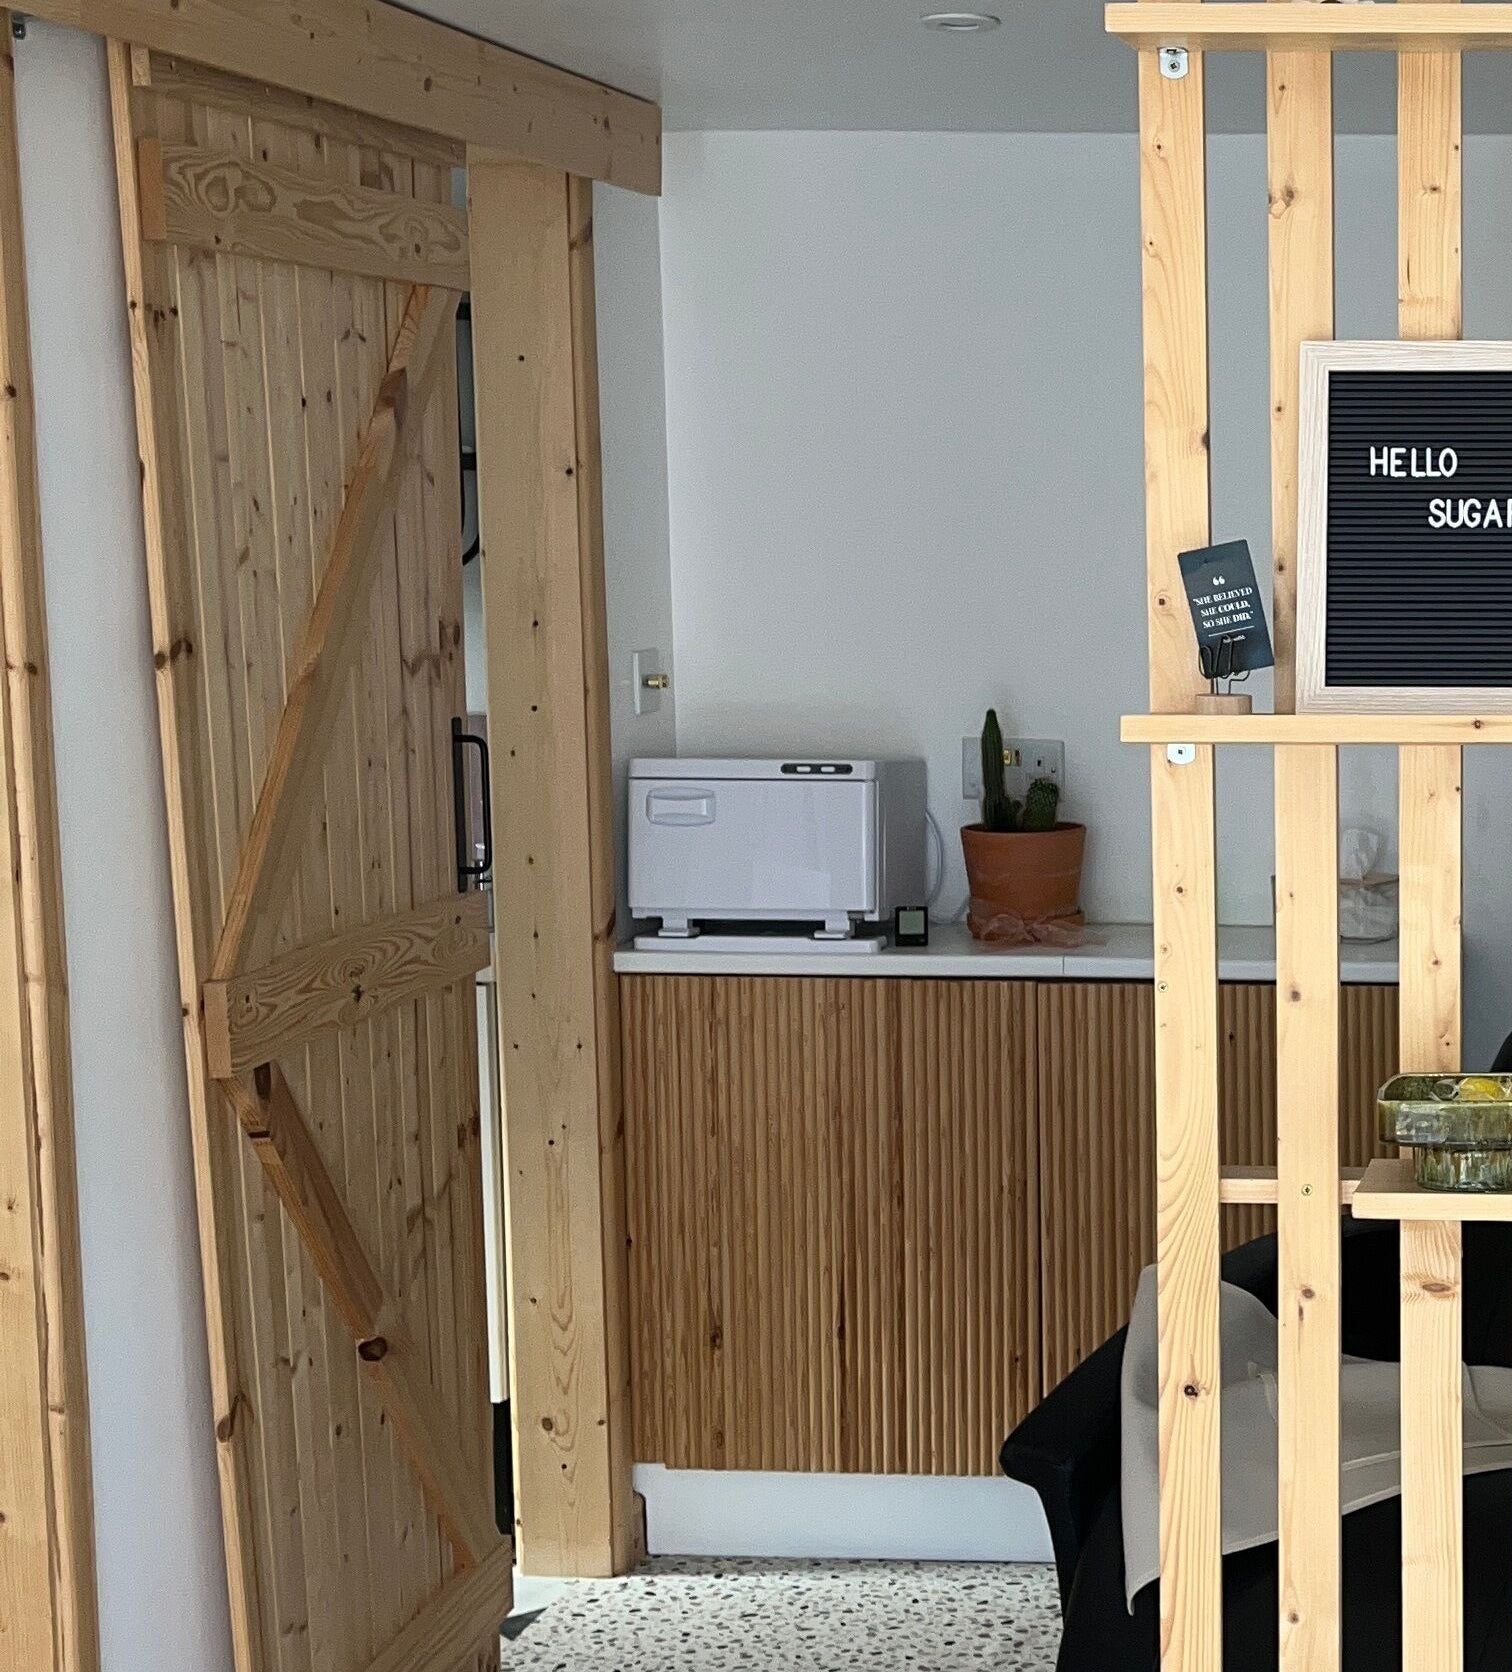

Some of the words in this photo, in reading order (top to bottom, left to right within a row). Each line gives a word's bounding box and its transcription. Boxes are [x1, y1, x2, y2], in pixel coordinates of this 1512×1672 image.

[1369, 446, 1458, 477] HELLO
[1213, 587, 1253, 602] BELIEVED
[1200, 606, 1217, 617] SHE
[1202, 619, 1215, 629] SO
[1216, 615, 1232, 626] SHE
